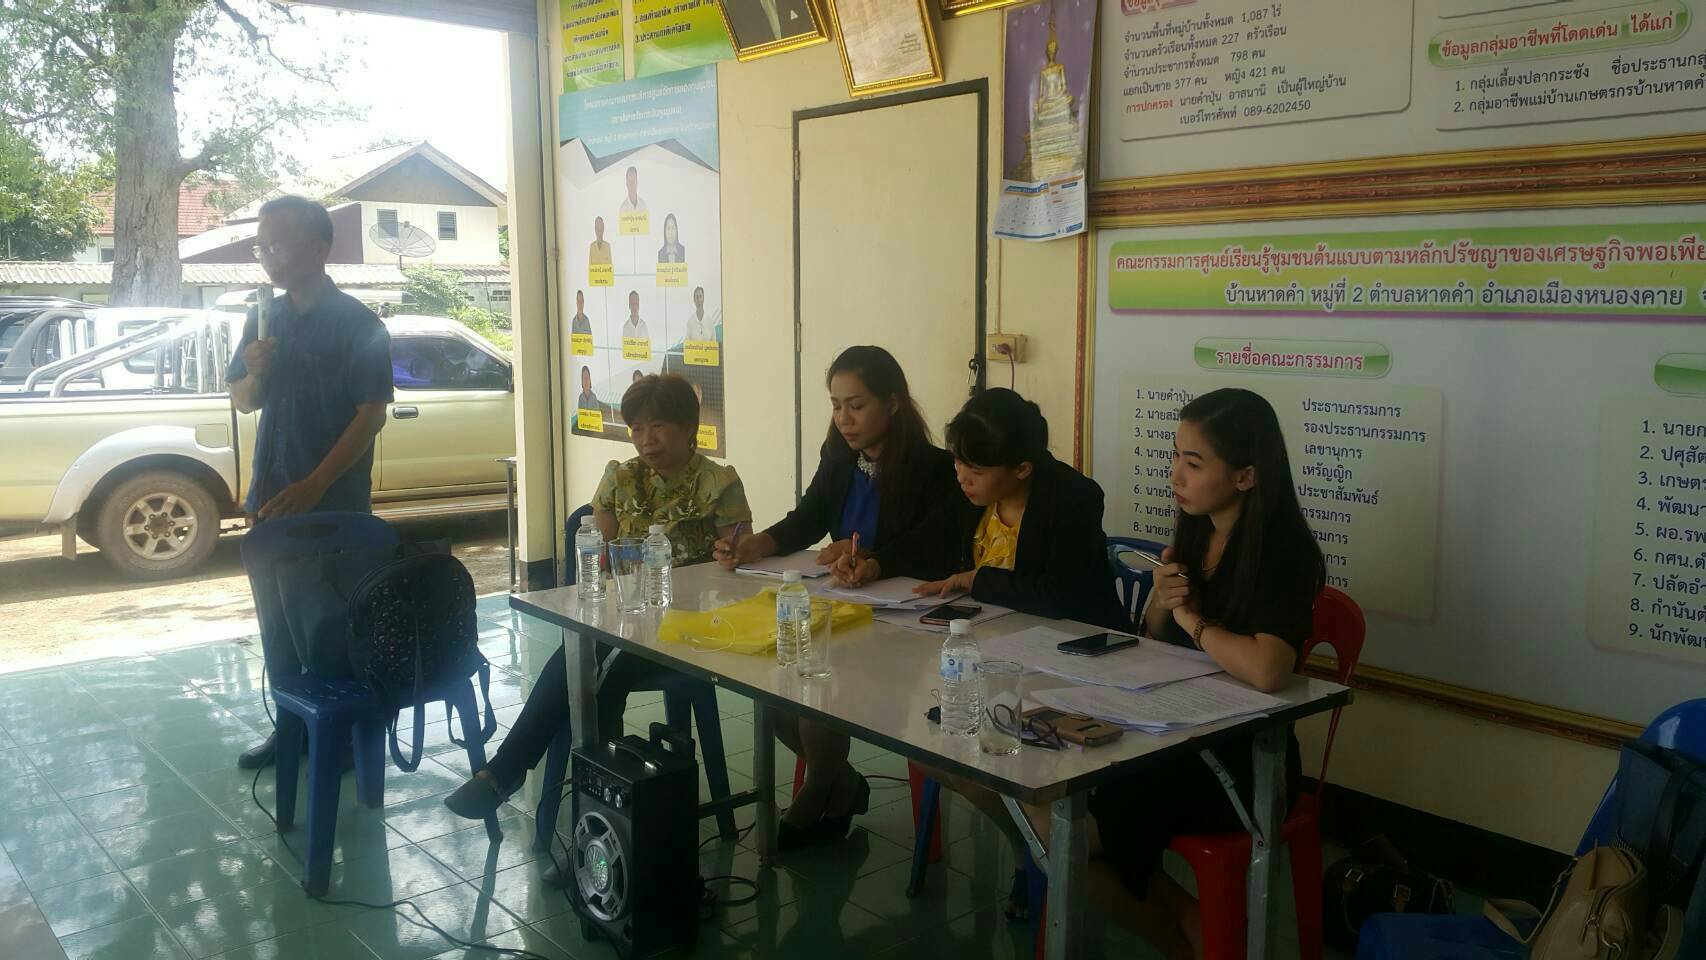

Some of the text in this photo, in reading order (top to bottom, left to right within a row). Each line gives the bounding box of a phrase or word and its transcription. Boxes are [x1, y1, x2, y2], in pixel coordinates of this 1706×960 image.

[1124, 5, 1282, 43] จำนวนพื้นที่หมู่บ้านทั้งหมด 1,087 ไร่
[1221, 33, 1239, 46] 227
[1246, 24, 1287, 42] ครัวเรือน
[1441, 11, 1673, 61] ข้อมูลกลุ่มอาชีพที่โดดเด่น ได้แก่
[1231, 50, 1249, 63] 798
[1252, 48, 1266, 60] คน
[1174, 76, 1192, 89] 377
[1194, 75, 1207, 87] คน
[1224, 63, 1246, 84] หญิง
[1249, 65, 1267, 78] 421
[1271, 64, 1286, 76] คน
[1455, 80, 1465, 92] 1.
[1470, 64, 1590, 94] กลุ่มเลี้ยงปลากระชัง
[1126, 97, 1174, 114] การปกครอง
[1277, 74, 1347, 99] เป็นผู้ใหญ่บ้าน
[1243, 99, 1311, 118] 089-6202450
[1453, 101, 1465, 113] 2.
[1226, 281, 1304, 303] บ้านหาดคำ
[1311, 278, 1347, 310] หมู่ที่
[1352, 286, 1363, 303] 2
[1370, 281, 1473, 304] ตำบลหาดคำ
[1482, 281, 1684, 306] อำเภอเมืองหนองคาย
[1216, 342, 1363, 371] รายชื่อคณะกรรมการ
[1136, 389, 1144, 400] 1.
[1134, 408, 1144, 419] 2.
[1302, 398, 1401, 418] ประธานกรรมการ
[1134, 427, 1143, 438] 3.
[1303, 420, 1426, 443] รองประธานกรรมการ
[1642, 420, 1655, 434] 1.
[1134, 446, 1143, 457] 4.
[1304, 442, 1362, 463] เลขานุการ
[1639, 445, 1654, 460] 2.
[1134, 465, 1143, 477] 5.
[1302, 462, 1353, 483] เหรัญญิก
[1638, 471, 1652, 485] 3.
[1133, 485, 1143, 496] 6.
[1133, 503, 1143, 515] 7.
[1636, 496, 1650, 511] 4.
[1133, 522, 1142, 533] 8.
[1634, 522, 1649, 537] 5.
[1312, 530, 1348, 545] รมการ
[1632, 548, 1647, 562] 6.
[1631, 573, 1646, 588] 7.
[1630, 598, 1644, 613] 8.
[1628, 623, 1706, 649] 9. นักพัฒ
